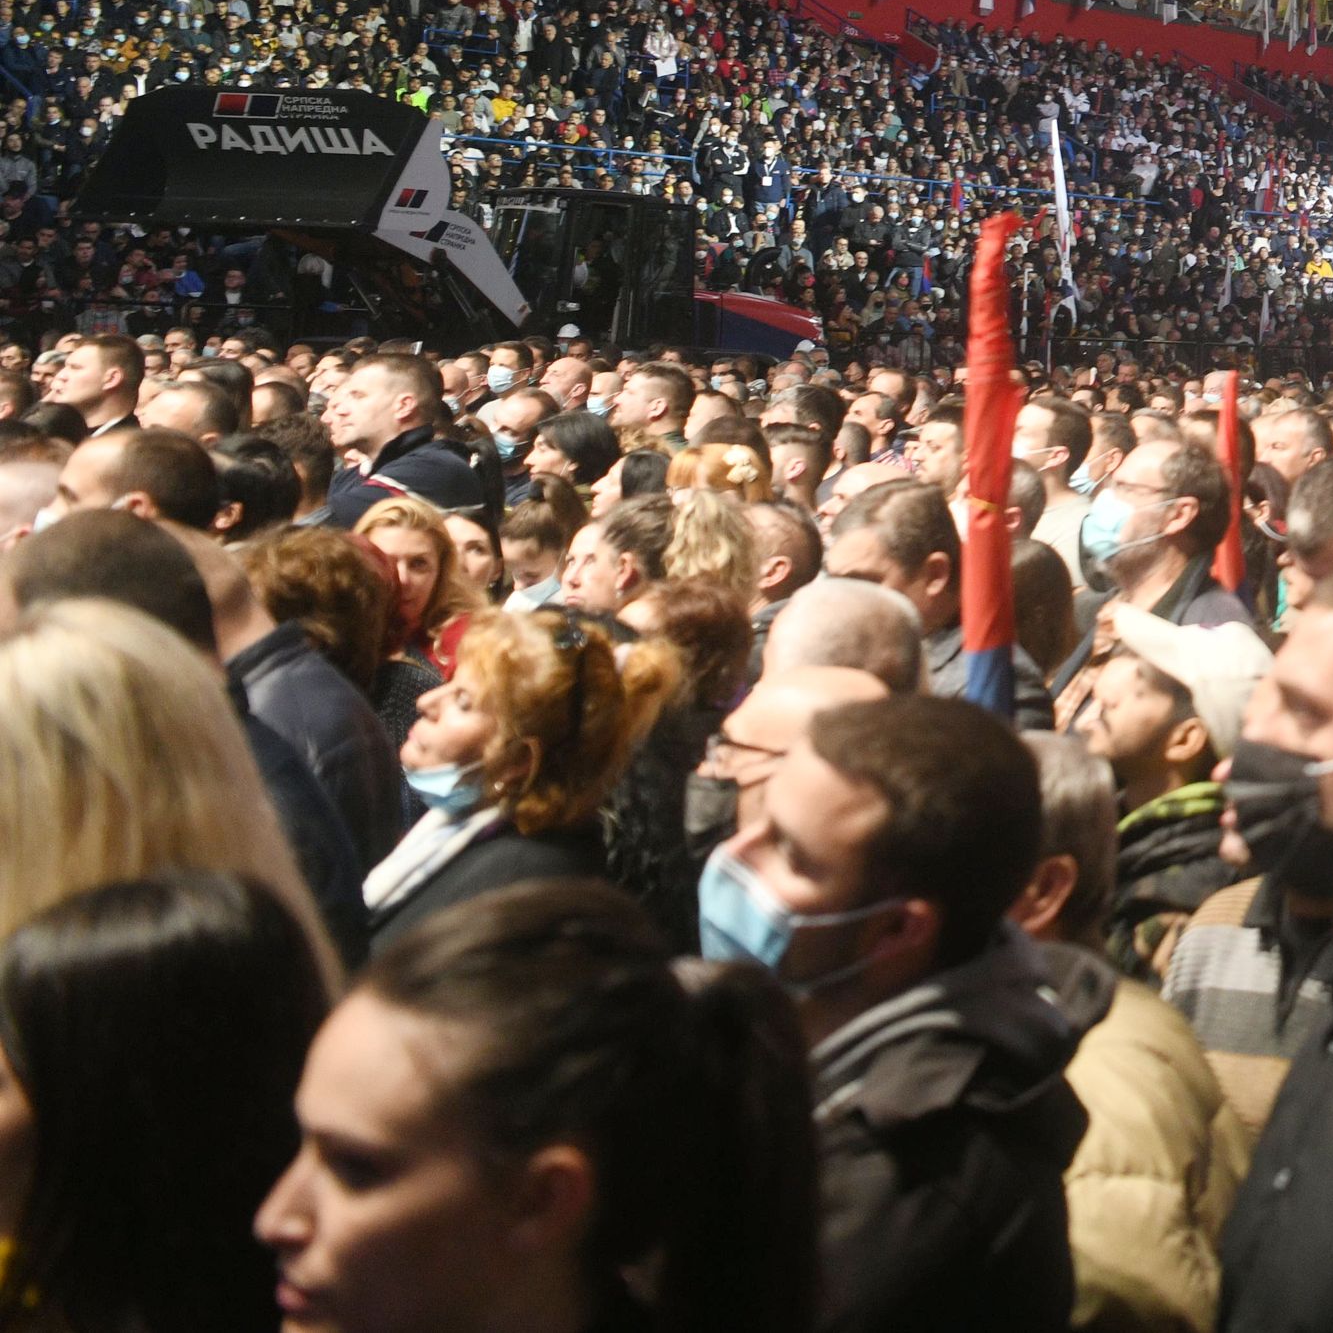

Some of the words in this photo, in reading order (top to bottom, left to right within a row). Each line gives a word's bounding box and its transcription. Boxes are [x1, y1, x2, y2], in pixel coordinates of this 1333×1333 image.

[284, 96, 331, 105] СРПСКА
[281, 104, 347, 114] НАПРЕДНА
[186, 122, 396, 156] РАДИША
